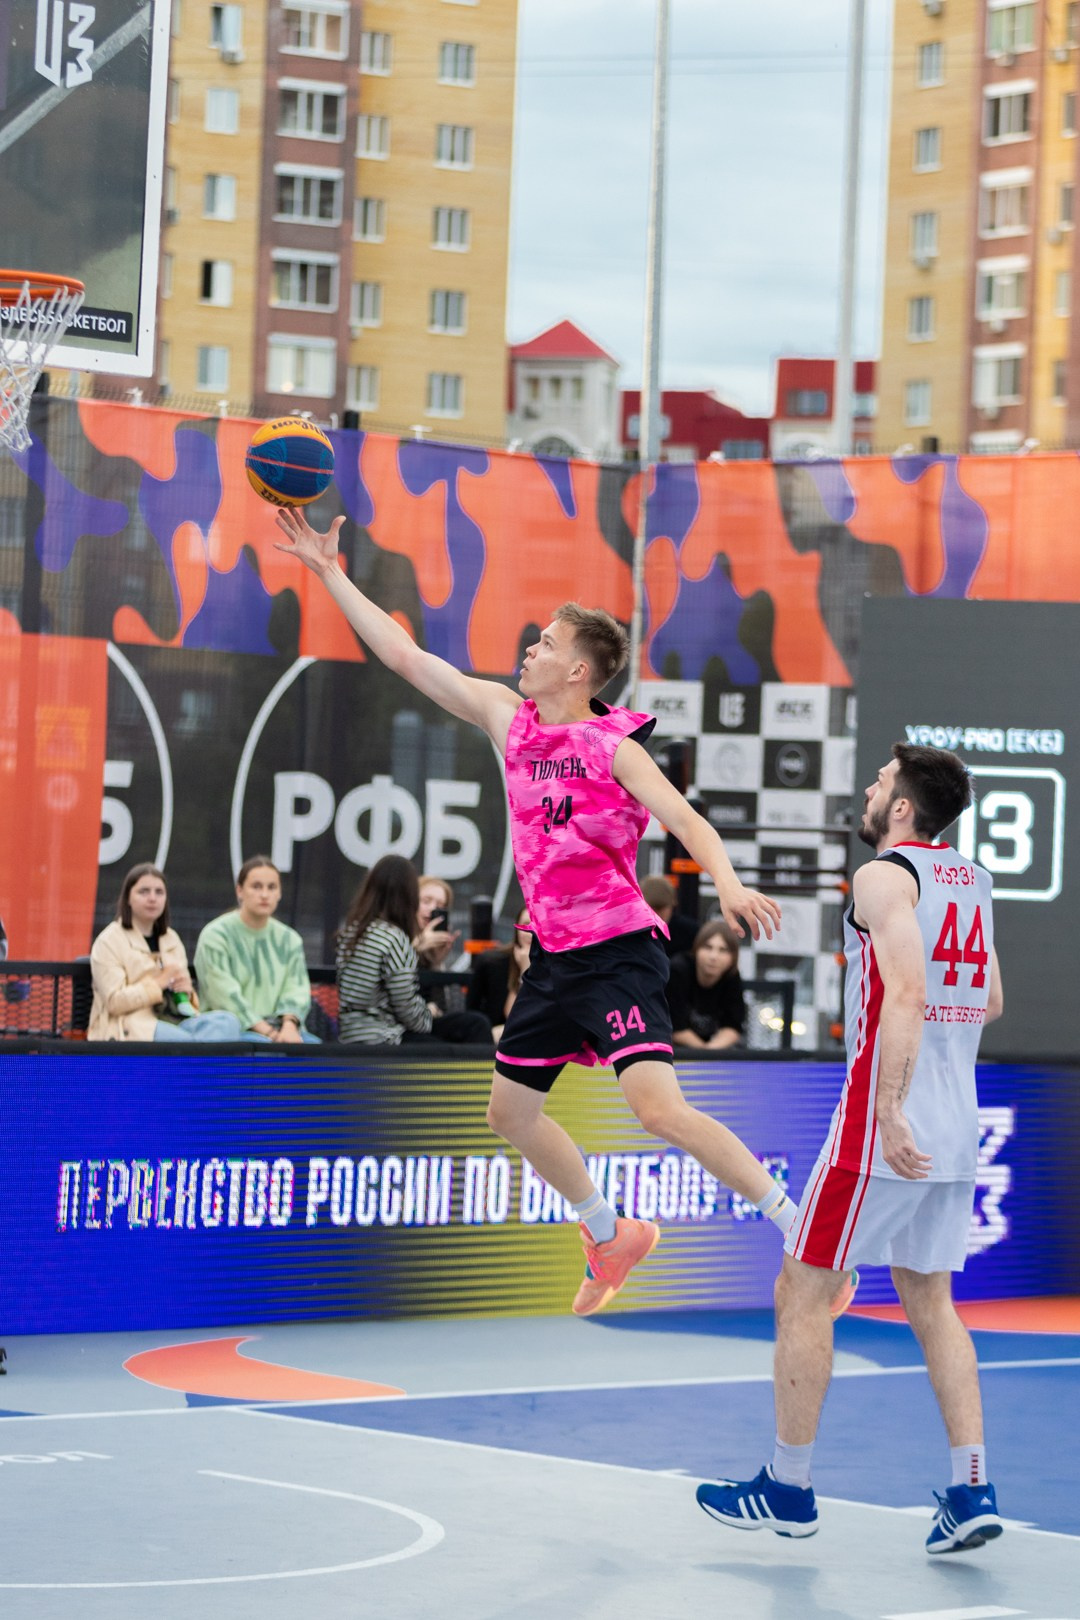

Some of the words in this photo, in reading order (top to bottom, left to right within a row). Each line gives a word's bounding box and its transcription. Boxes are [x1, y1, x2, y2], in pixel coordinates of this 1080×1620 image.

[531, 757, 587, 781] ТЮМЕНЬ
[271, 771, 482, 880] РФБ
[541, 795, 573, 834] 34
[931, 902, 988, 988] 44
[606, 1005, 646, 1041] 34
[56, 1157, 294, 1232] ПЕРВЕНСТВО
[306, 1155, 452, 1228] РОССИИ
[463, 1155, 510, 1225] ПО
